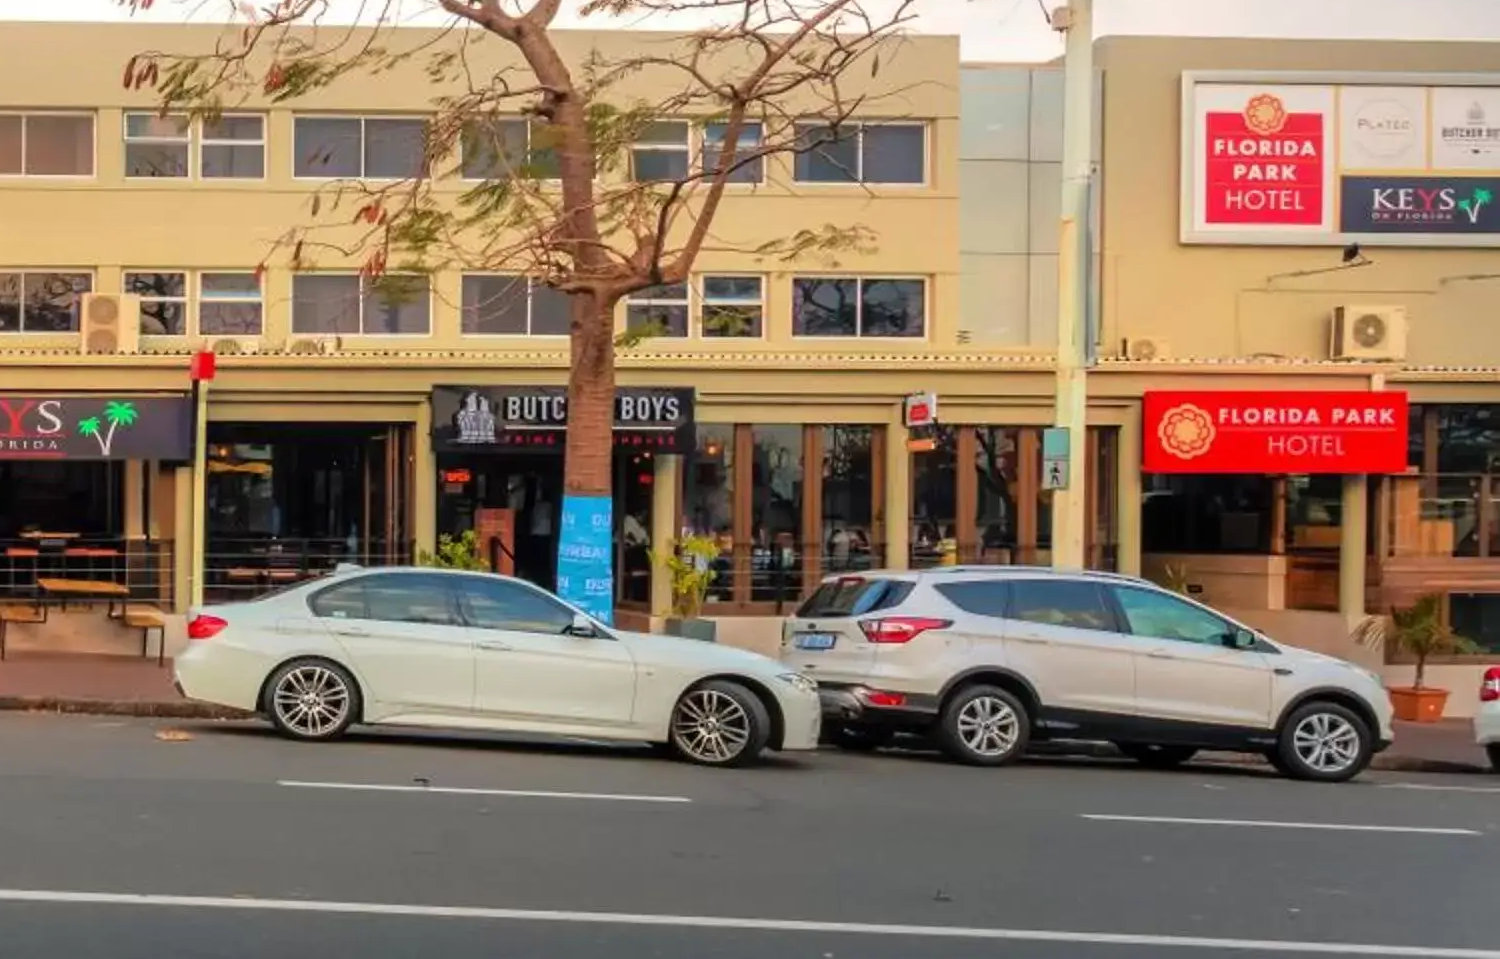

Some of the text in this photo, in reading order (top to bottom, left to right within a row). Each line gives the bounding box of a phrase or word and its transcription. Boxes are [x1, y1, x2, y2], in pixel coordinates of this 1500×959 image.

[1214, 139, 1316, 156] FLORIDA
[1233, 164, 1297, 180] PARK
[1225, 190, 1305, 210] HOTEL
[1372, 188, 1455, 211] KEYS
[508, 396, 679, 421] BUTC BOYS
[1219, 408, 1395, 424] FLORIDA PARK
[1268, 436, 1345, 455] HOTEL
